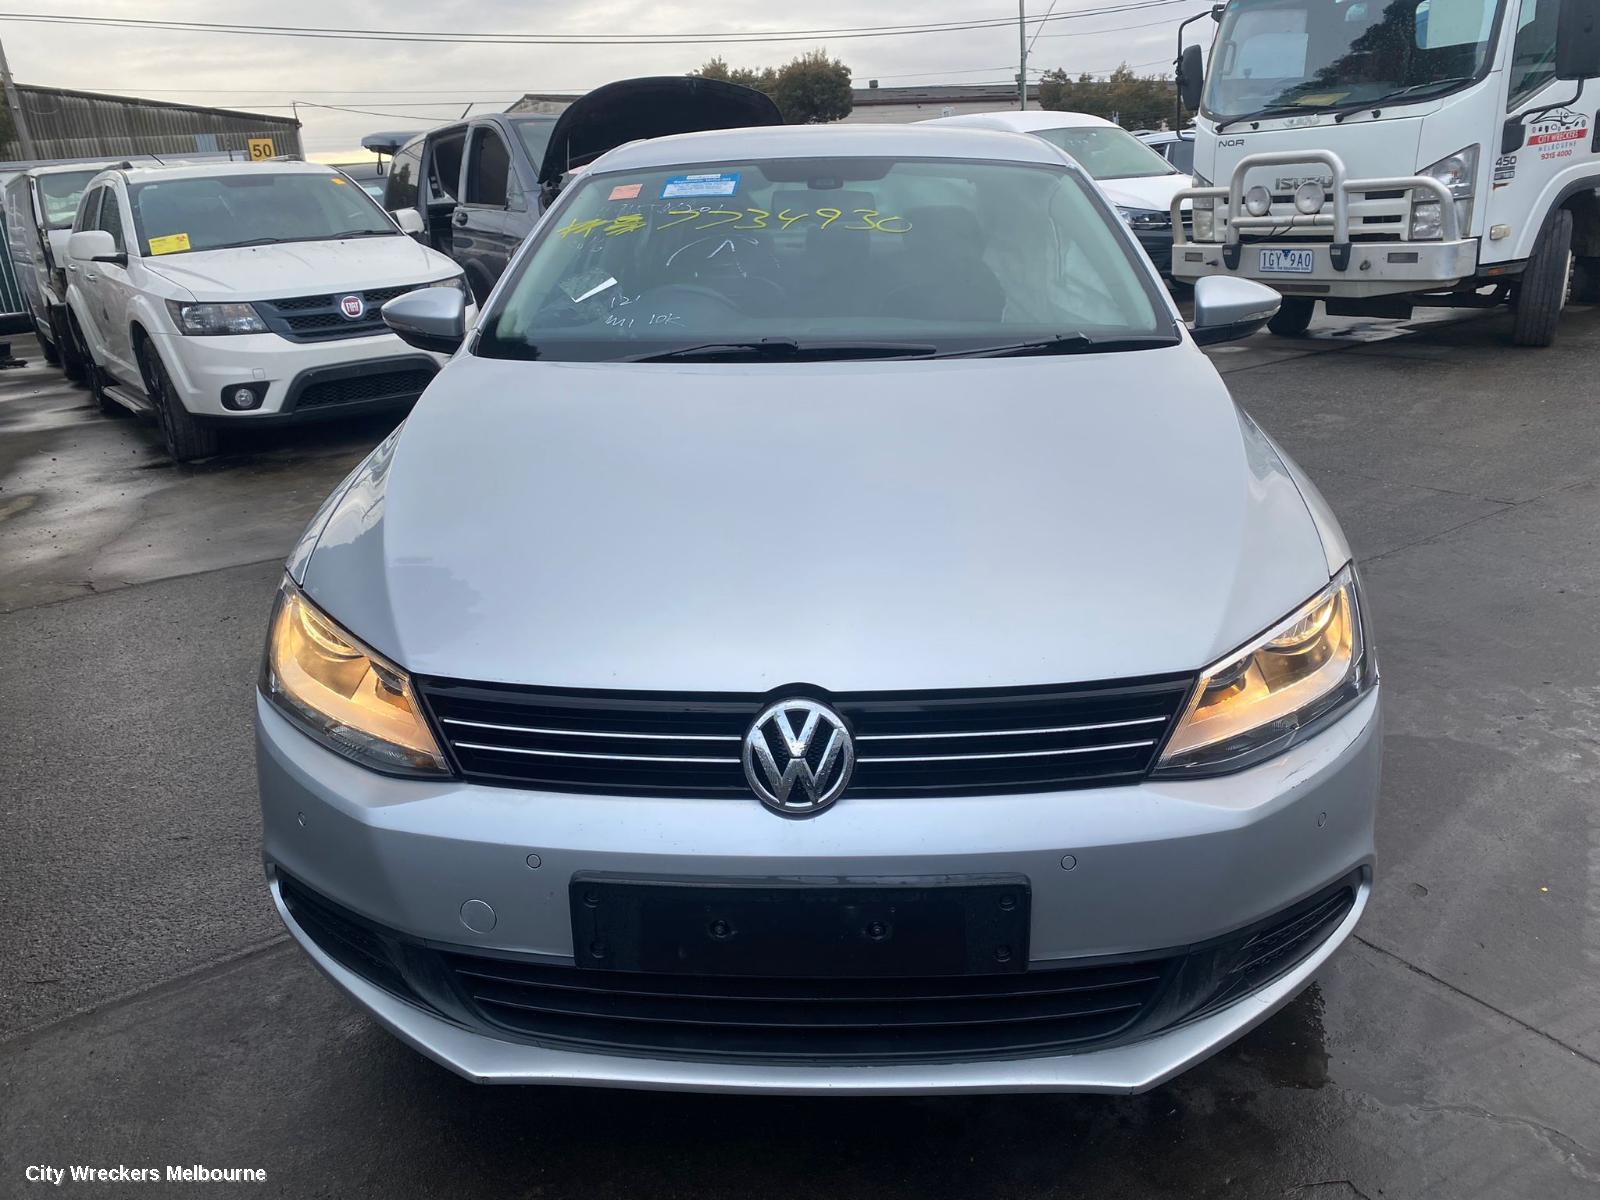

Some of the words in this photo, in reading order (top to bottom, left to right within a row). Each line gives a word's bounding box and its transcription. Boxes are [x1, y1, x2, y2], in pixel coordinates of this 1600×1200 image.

[252, 143, 272, 158] 50
[1495, 155, 1517, 166] 450
[1262, 252, 1281, 267] 1GY
